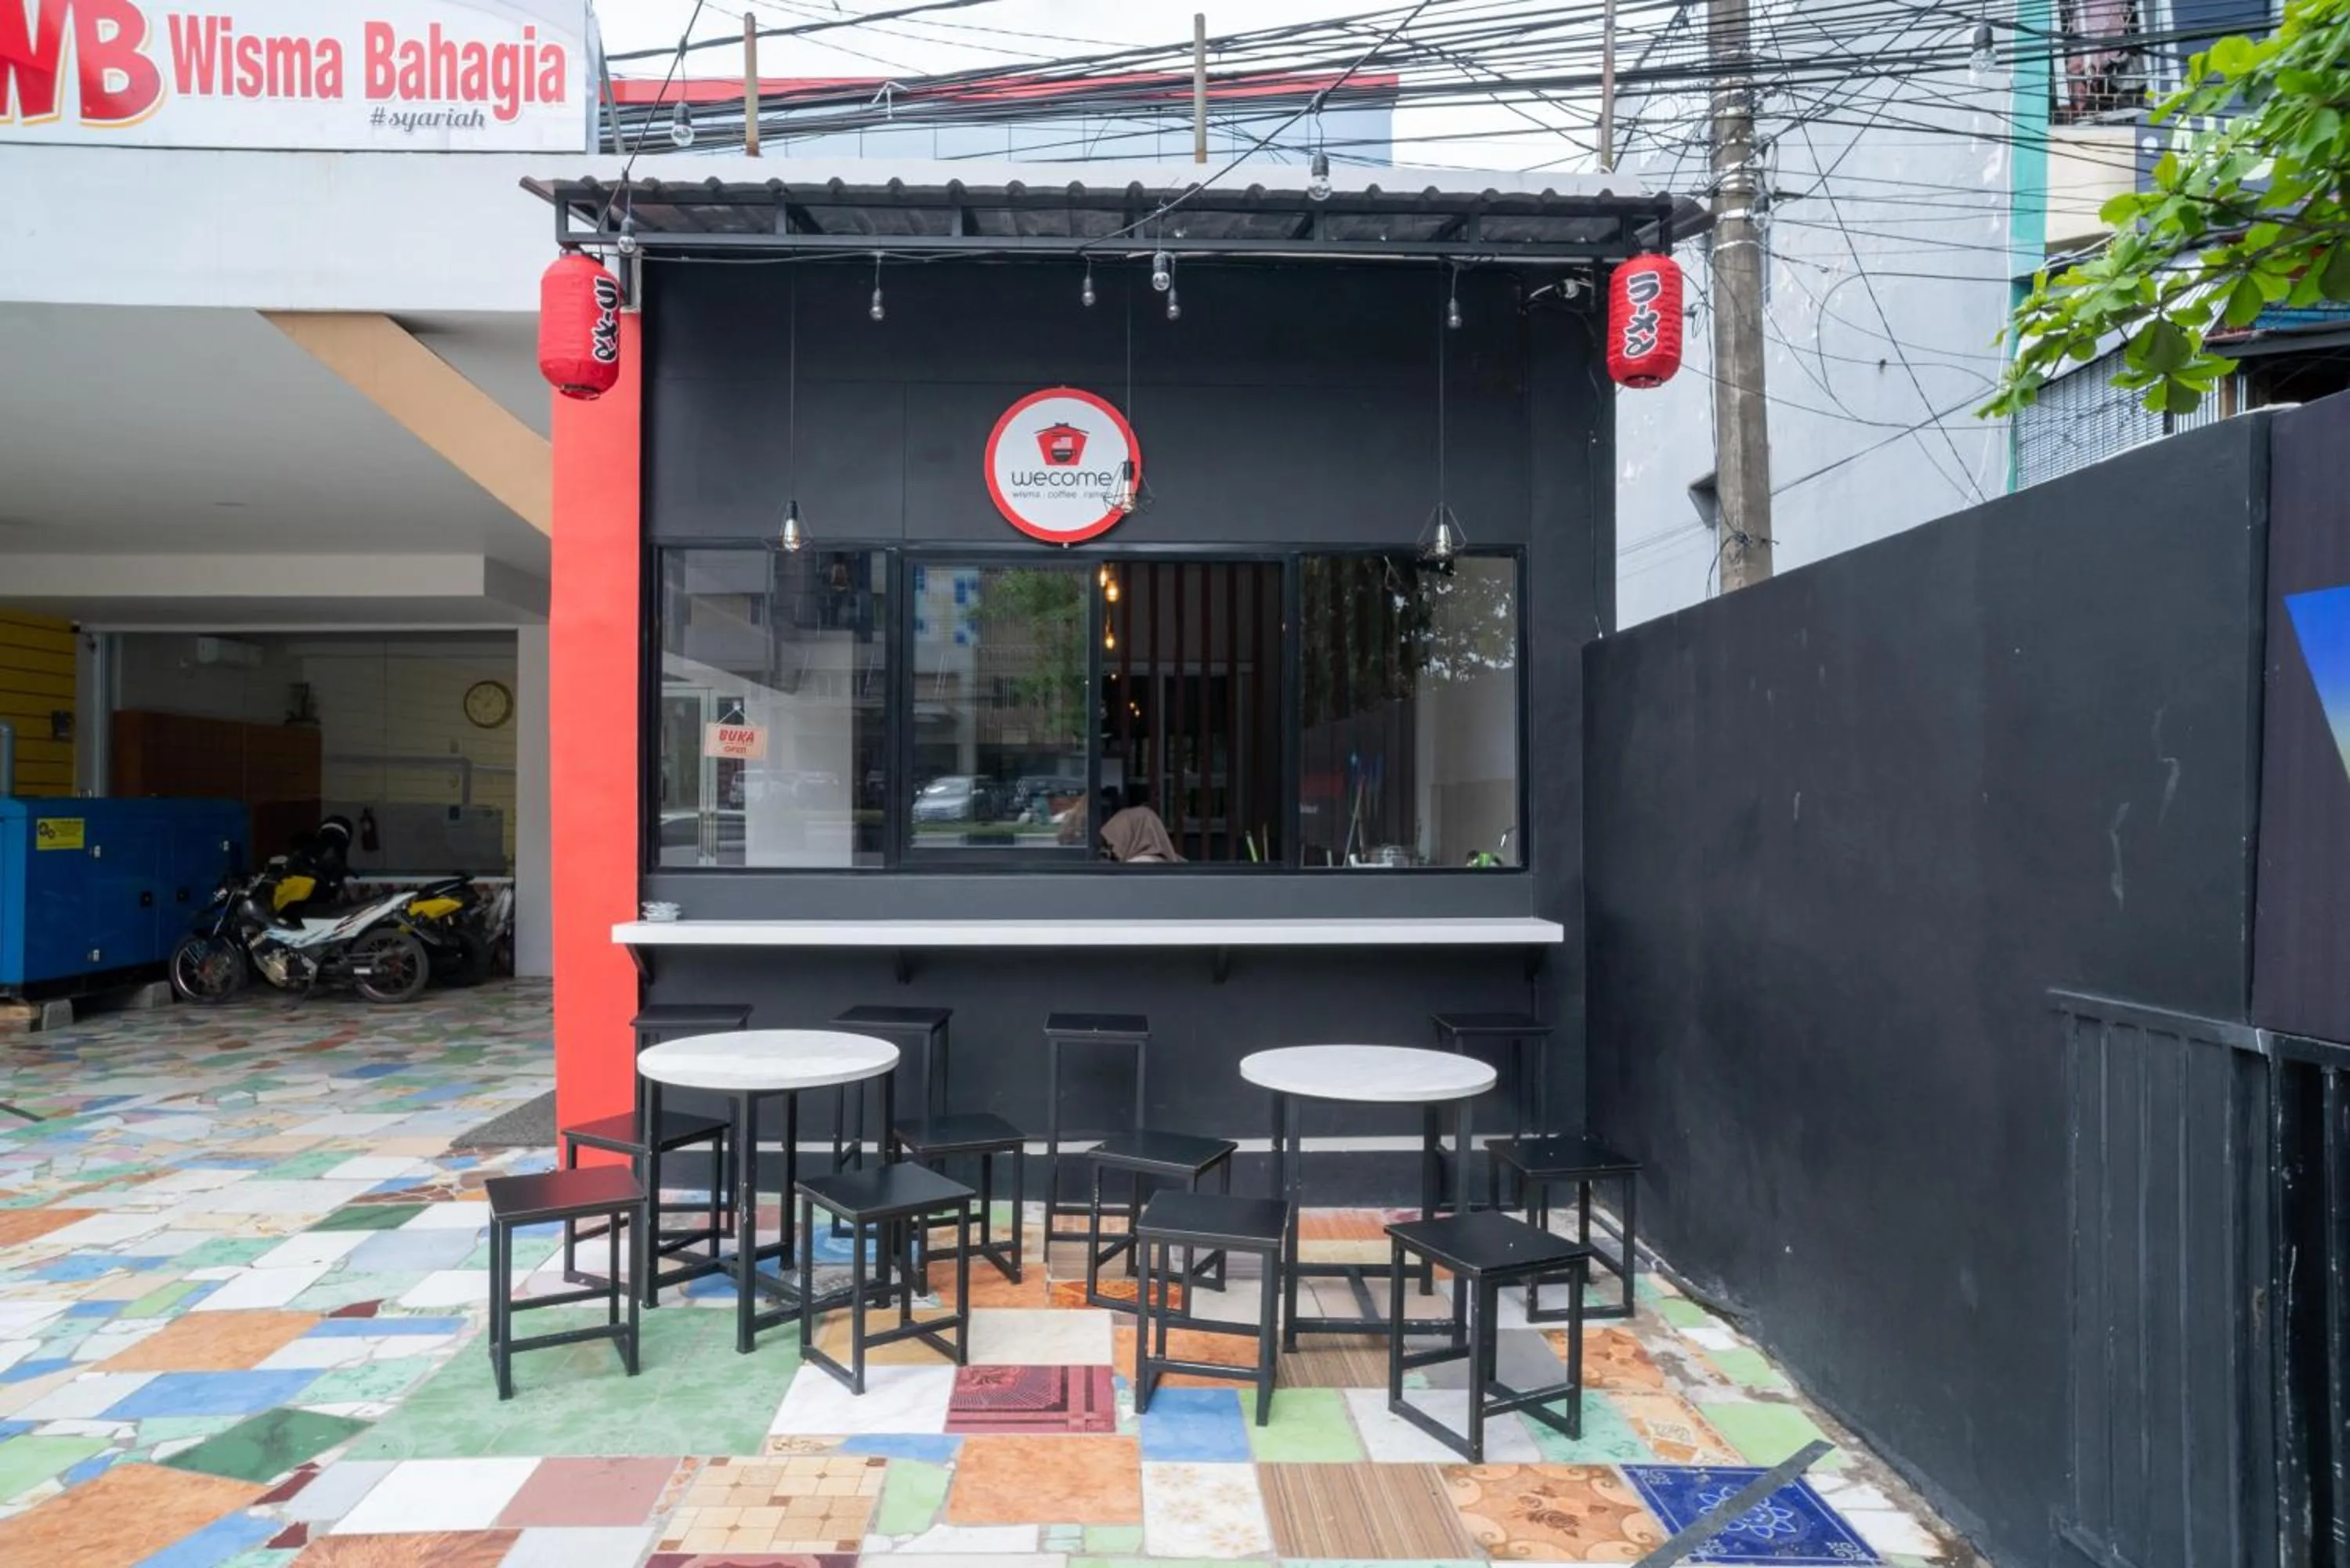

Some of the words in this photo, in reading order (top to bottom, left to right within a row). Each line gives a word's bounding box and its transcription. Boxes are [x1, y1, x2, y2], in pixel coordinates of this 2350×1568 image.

[168, 14, 343, 99] Wisma
[364, 21, 566, 121] Bahagia
[370, 107, 486, 132] #syariah
[592, 276, 618, 363] ラーメン
[1625, 272, 1661, 359] ラーメン
[1011, 471, 1112, 486] wecome
[719, 729, 754, 743] BUKA
